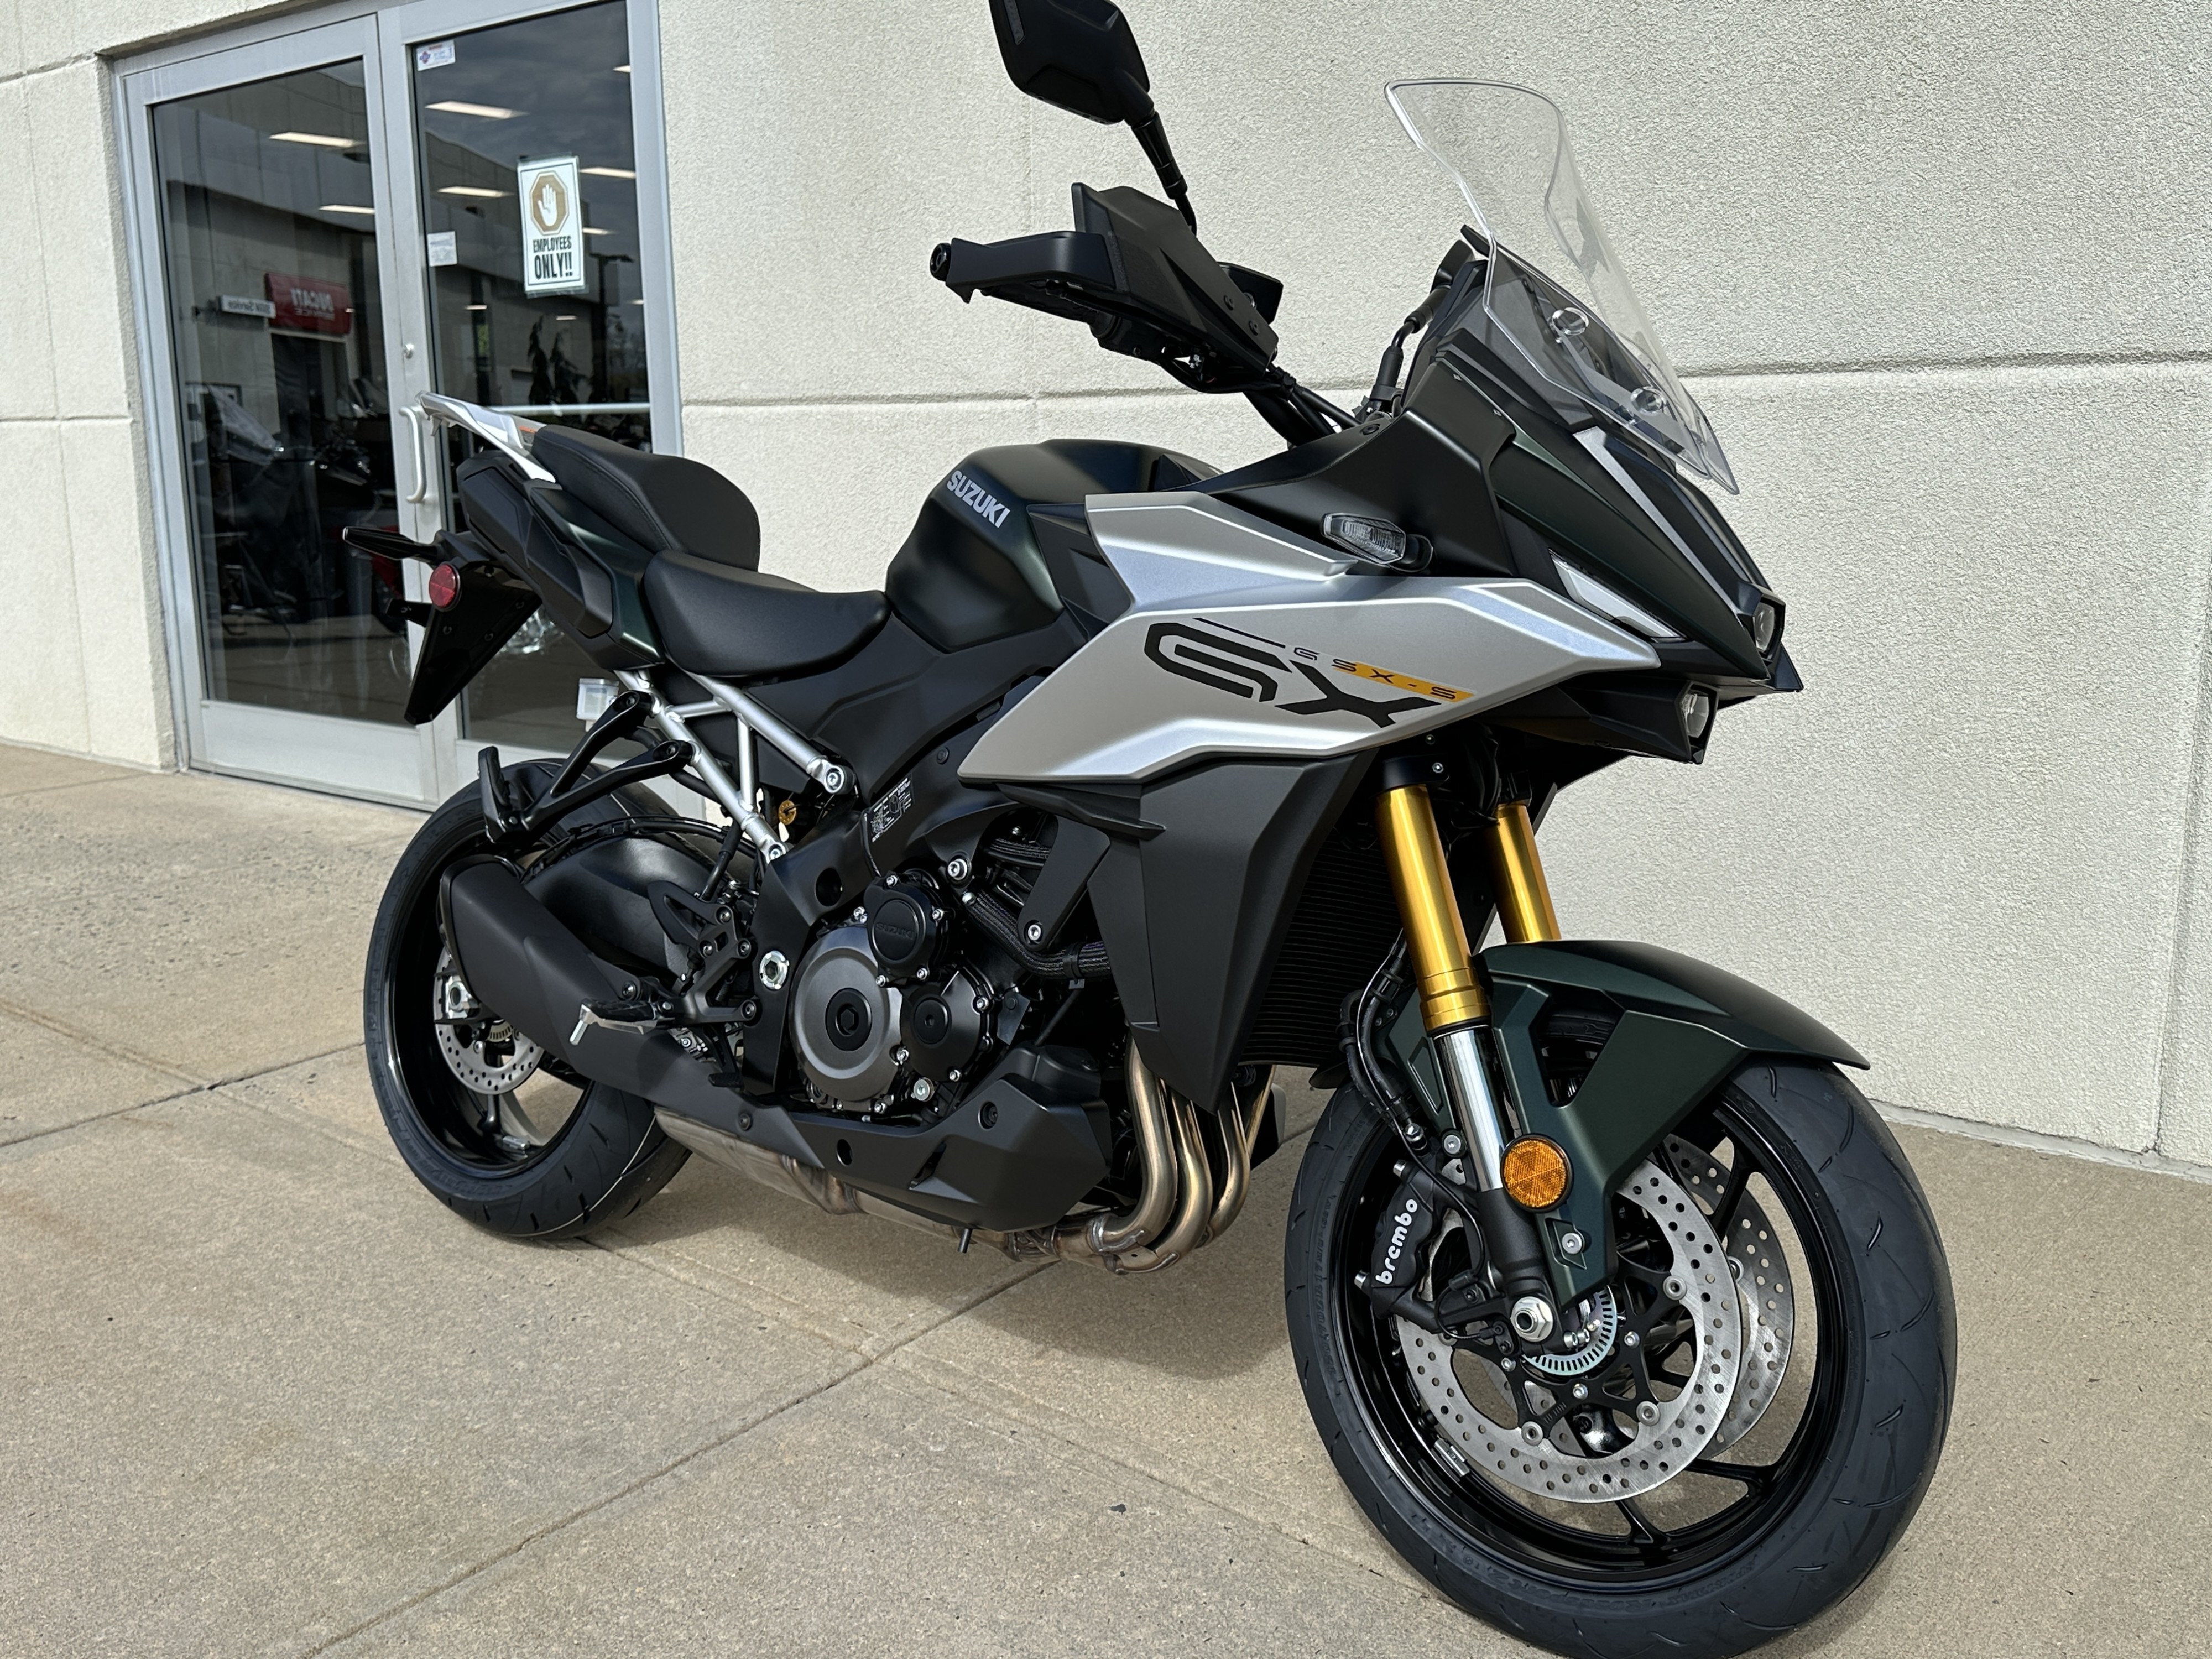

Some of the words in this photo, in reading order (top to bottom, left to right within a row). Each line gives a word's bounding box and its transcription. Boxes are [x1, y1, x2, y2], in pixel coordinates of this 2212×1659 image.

[533, 236, 572, 253] EMPLOYEES
[534, 252, 573, 280] ONLY!!
[947, 470, 1011, 529] SUZUKI
[875, 922, 914, 940] SUZUKI
[1375, 1198, 1418, 1285] brembo
